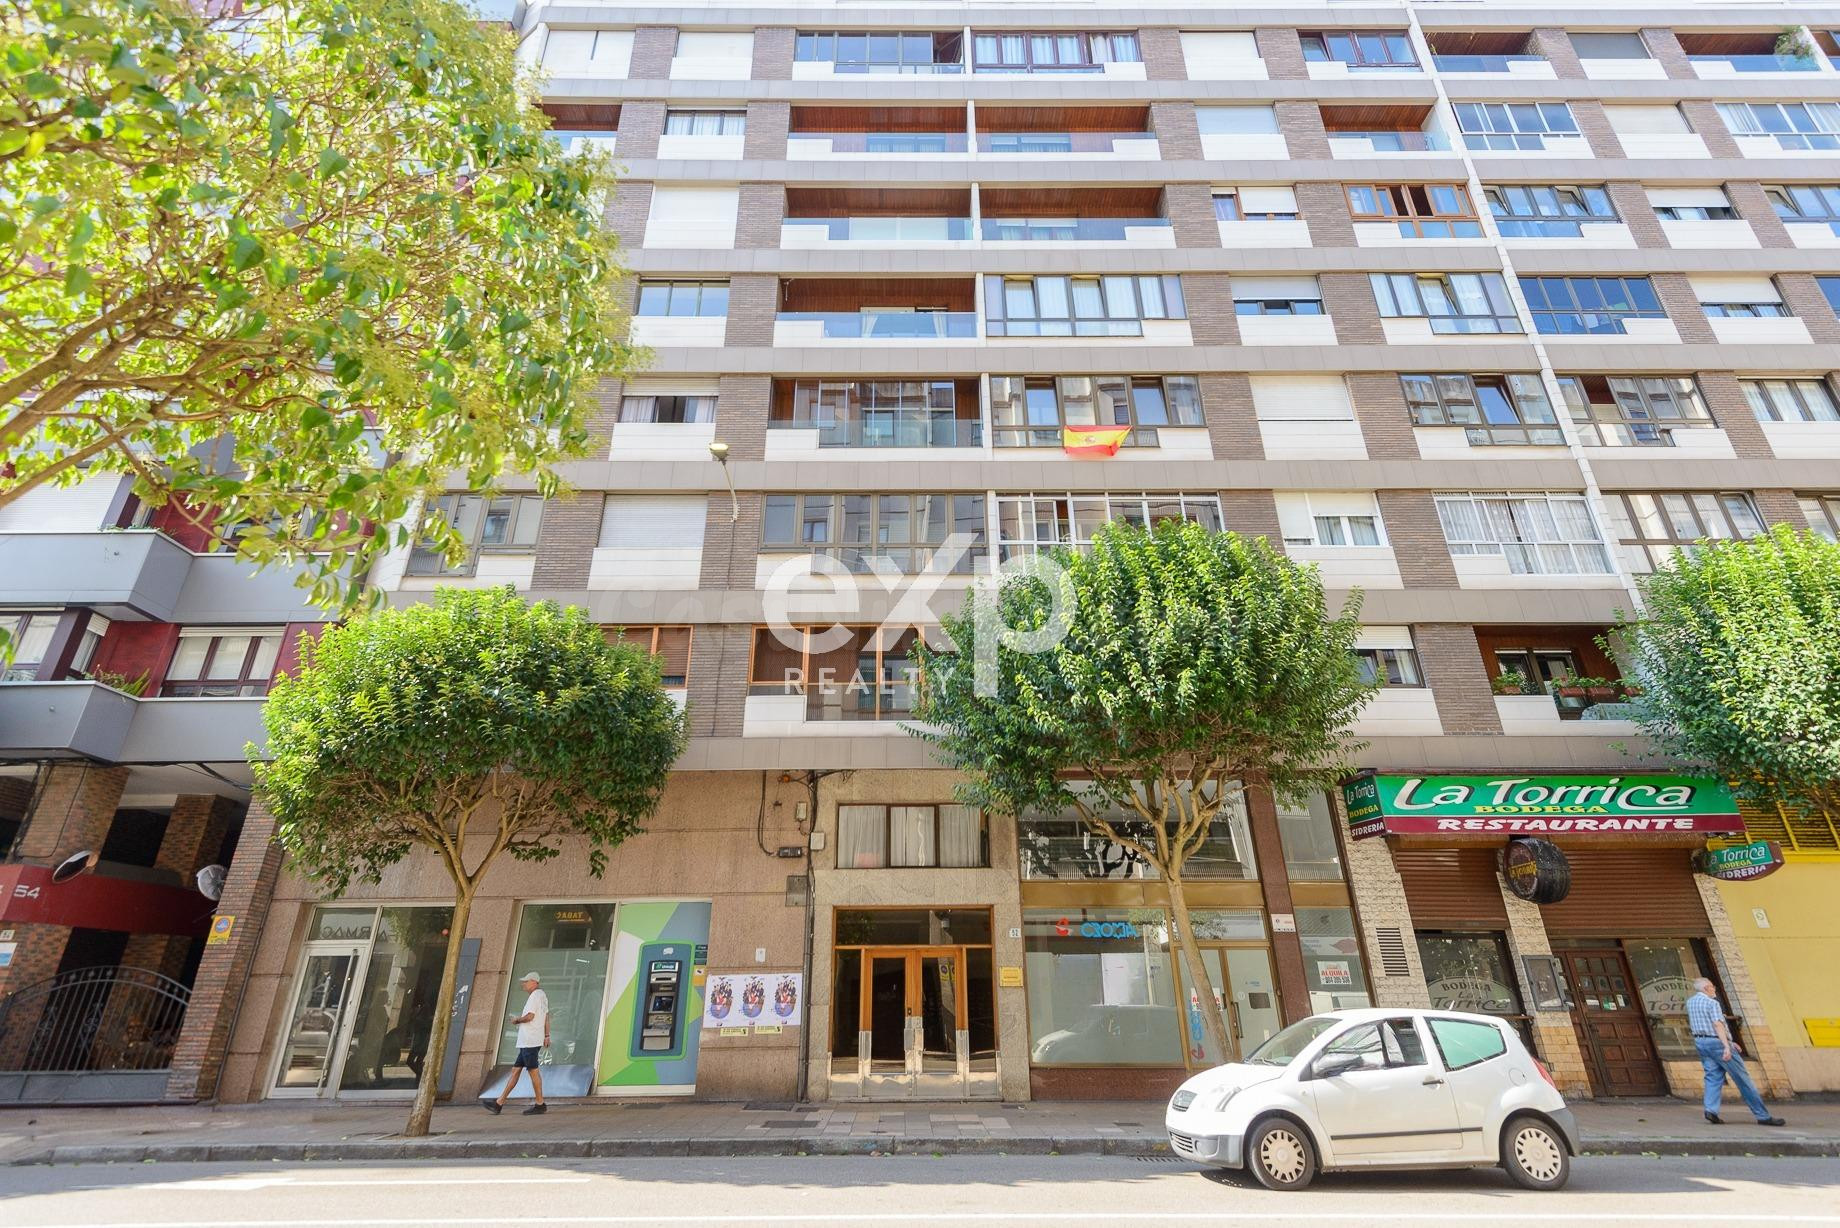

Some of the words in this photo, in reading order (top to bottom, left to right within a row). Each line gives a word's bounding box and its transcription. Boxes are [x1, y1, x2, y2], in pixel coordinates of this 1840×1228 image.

[1346, 789, 1355, 805] La
[1393, 778, 1471, 810] La
[1349, 804, 1379, 818] BODEGA
[1473, 805, 1609, 813] BODEGA
[1351, 822, 1385, 836] SIDRERIA
[1437, 818, 1694, 831] RESTAURANTE
[1717, 865, 1767, 878] SIDRERIA
[1719, 859, 1753, 871] BODEGA
[13, 884, 41, 899] 54
[1441, 981, 1492, 992] BODEGA
[1648, 1000, 1686, 1011] Torr
